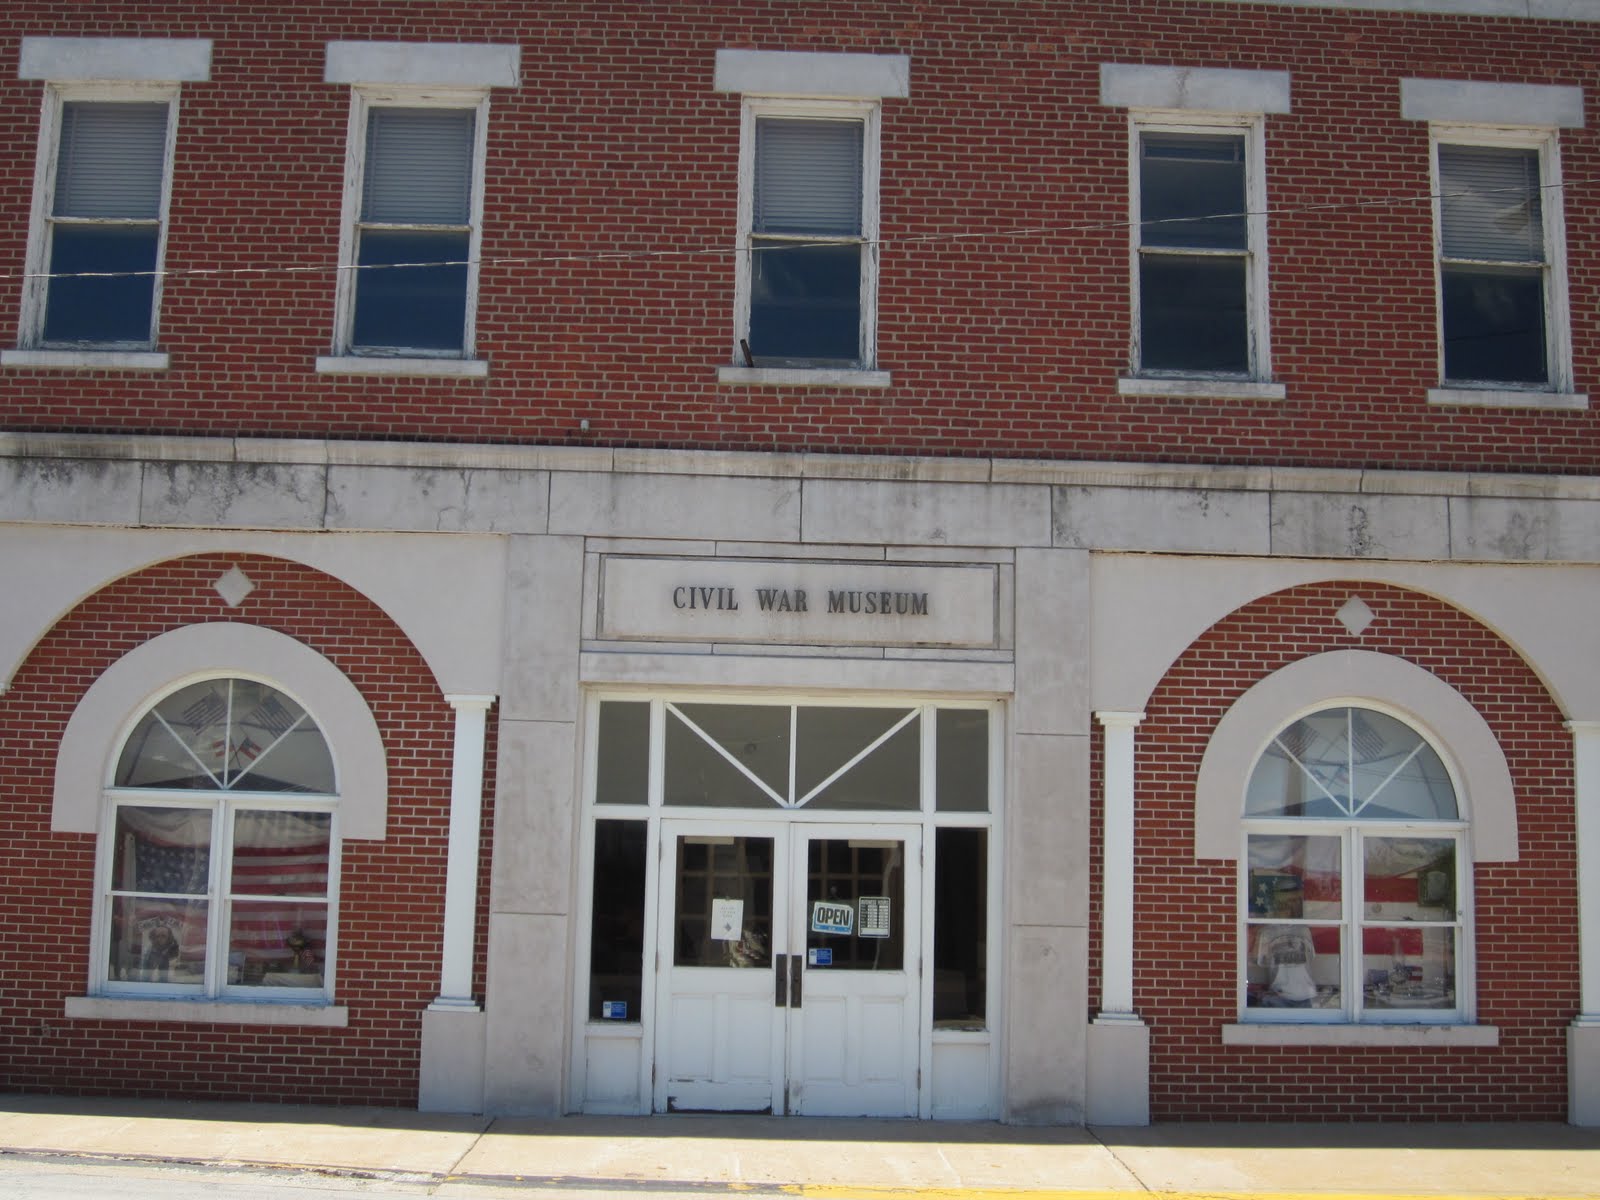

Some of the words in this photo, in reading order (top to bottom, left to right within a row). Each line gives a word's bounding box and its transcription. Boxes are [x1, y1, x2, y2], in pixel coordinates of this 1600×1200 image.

[673, 586, 738, 610] CIVIL
[755, 588, 809, 613] WAR
[827, 590, 929, 615] MUSEUM
[816, 907, 850, 926] OPEN
